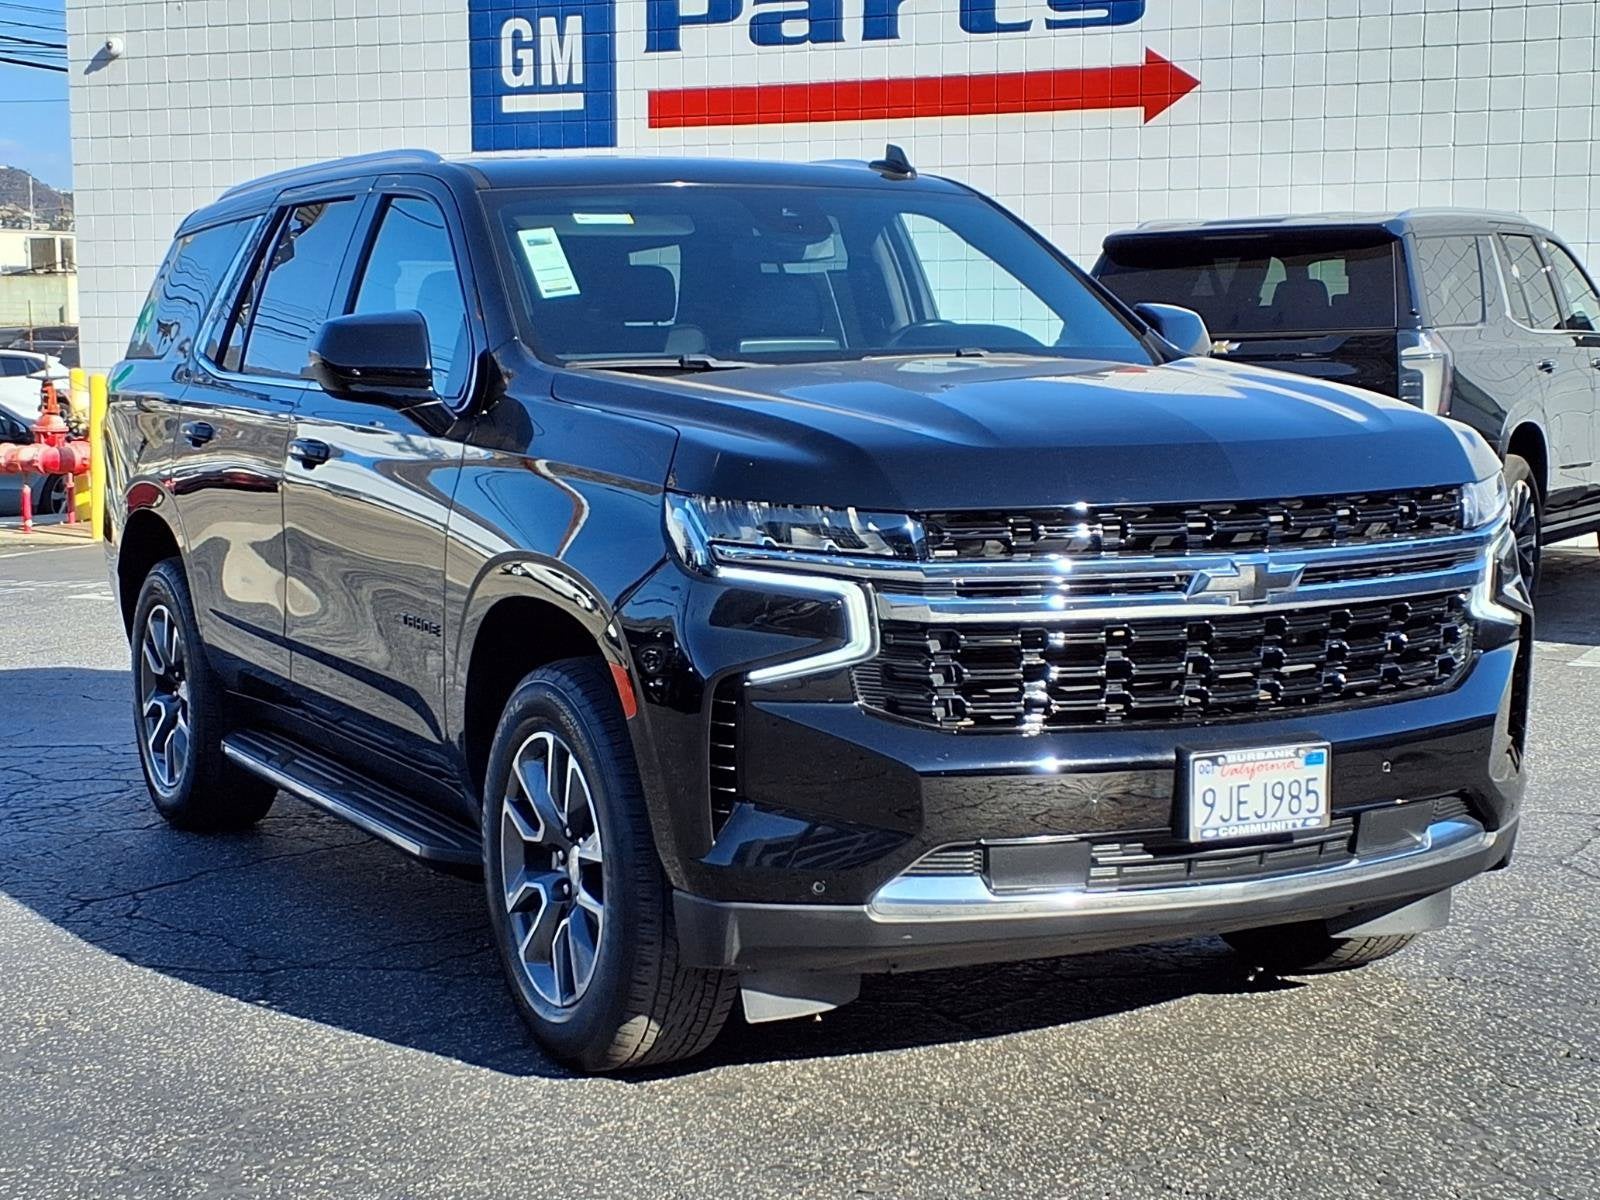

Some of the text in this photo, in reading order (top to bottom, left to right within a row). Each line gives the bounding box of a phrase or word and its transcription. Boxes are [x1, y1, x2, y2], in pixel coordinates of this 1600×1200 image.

[500, 15, 584, 87] GM
[1225, 750, 1297, 763] BURBANK
[1220, 760, 1304, 780] California
[1202, 777, 1320, 825] 9JEJ985
[1218, 818, 1305, 837] COMMUNITY
